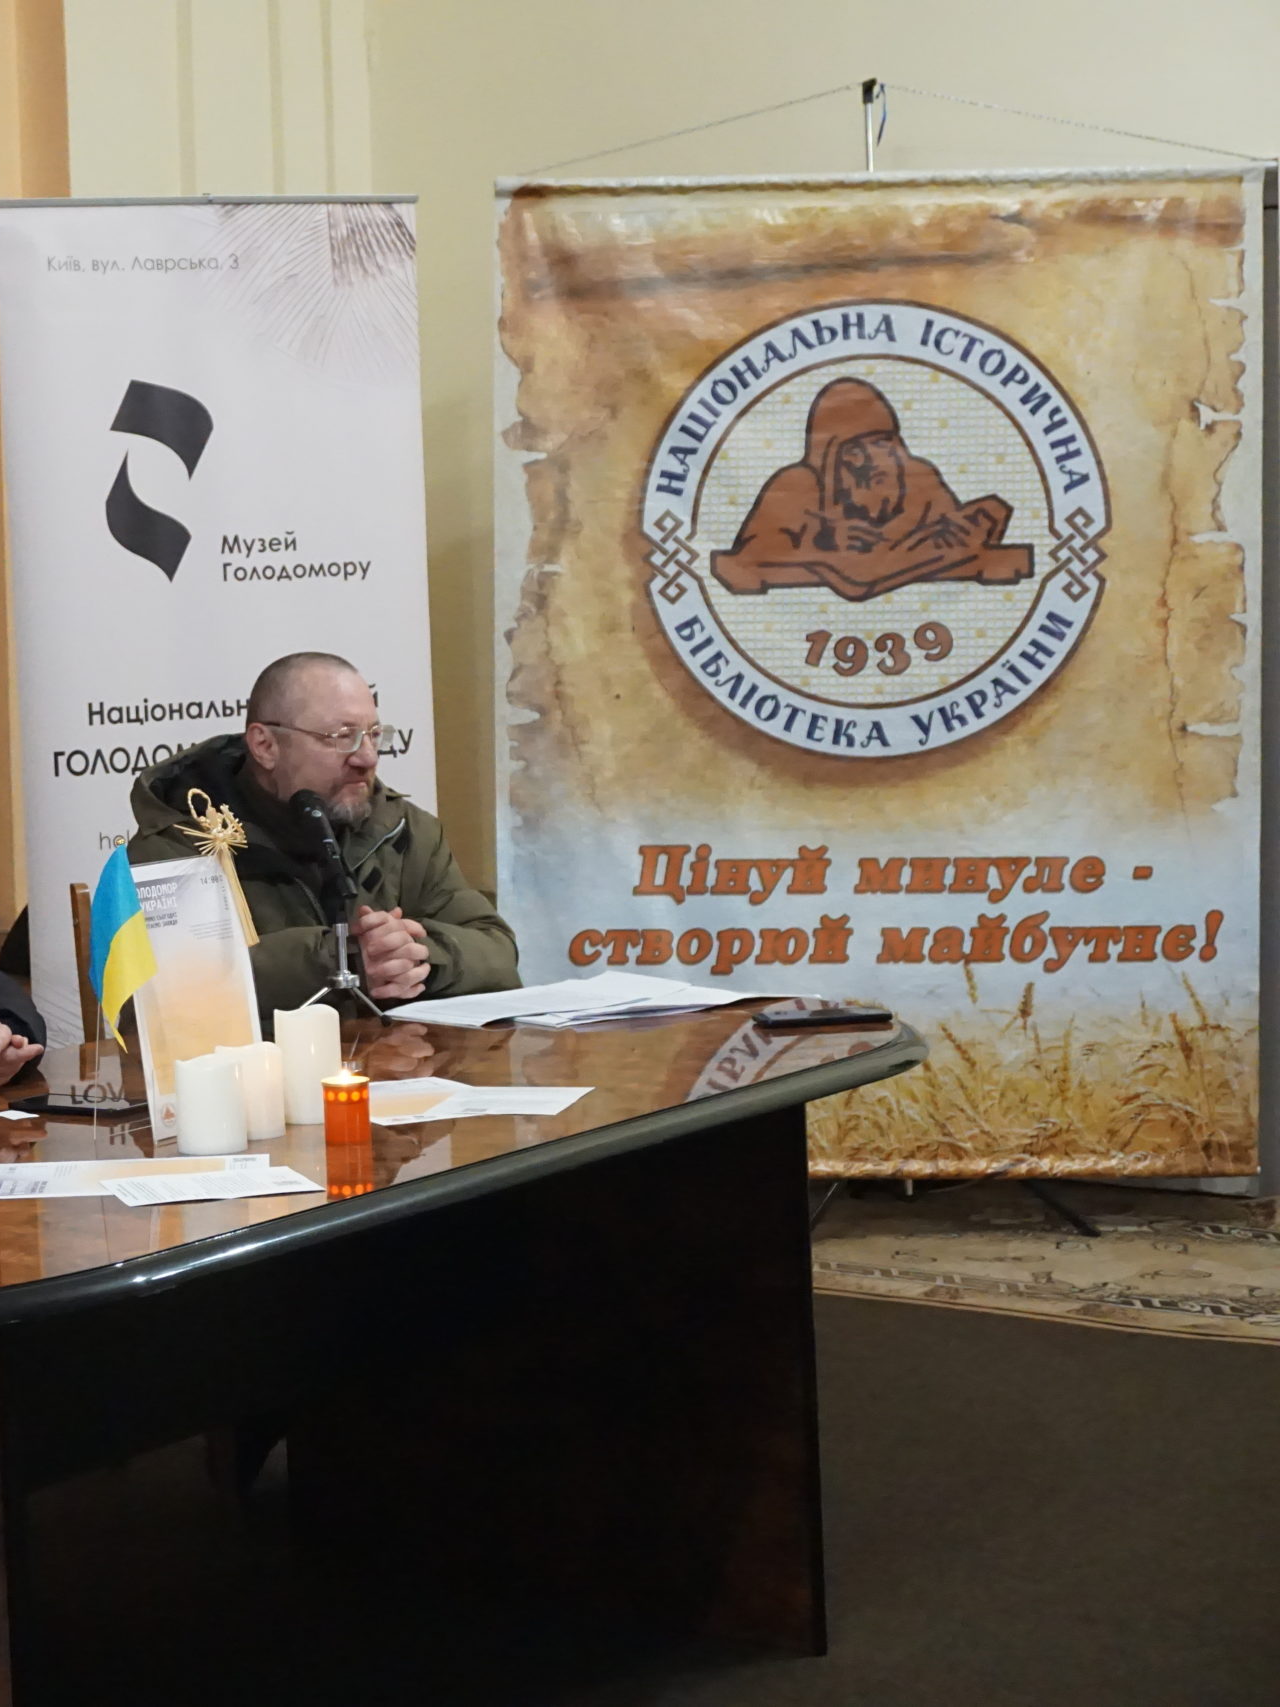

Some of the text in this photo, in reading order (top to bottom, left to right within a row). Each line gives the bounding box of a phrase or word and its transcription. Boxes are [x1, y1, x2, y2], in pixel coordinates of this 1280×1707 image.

[47, 255, 86, 273] Київ,
[91, 260, 126, 275] вул.
[228, 252, 240, 271] 3
[655, 311, 1091, 497] НАЦІОНАЛЬНА ІСТОРИЧНА
[221, 529, 298, 558] Музей
[222, 560, 372, 582] Голодомору
[804, 620, 955, 678] 1939
[673, 609, 1076, 749] БІБЛІОТЕКА УКРАЇНИ
[87, 697, 251, 727] Національн
[53, 742, 196, 778] ГОЛОДО
[632, 843, 832, 906] Цінуй
[853, 854, 1107, 905] минуле
[568, 909, 1226, 976] створюй майбутнє!
